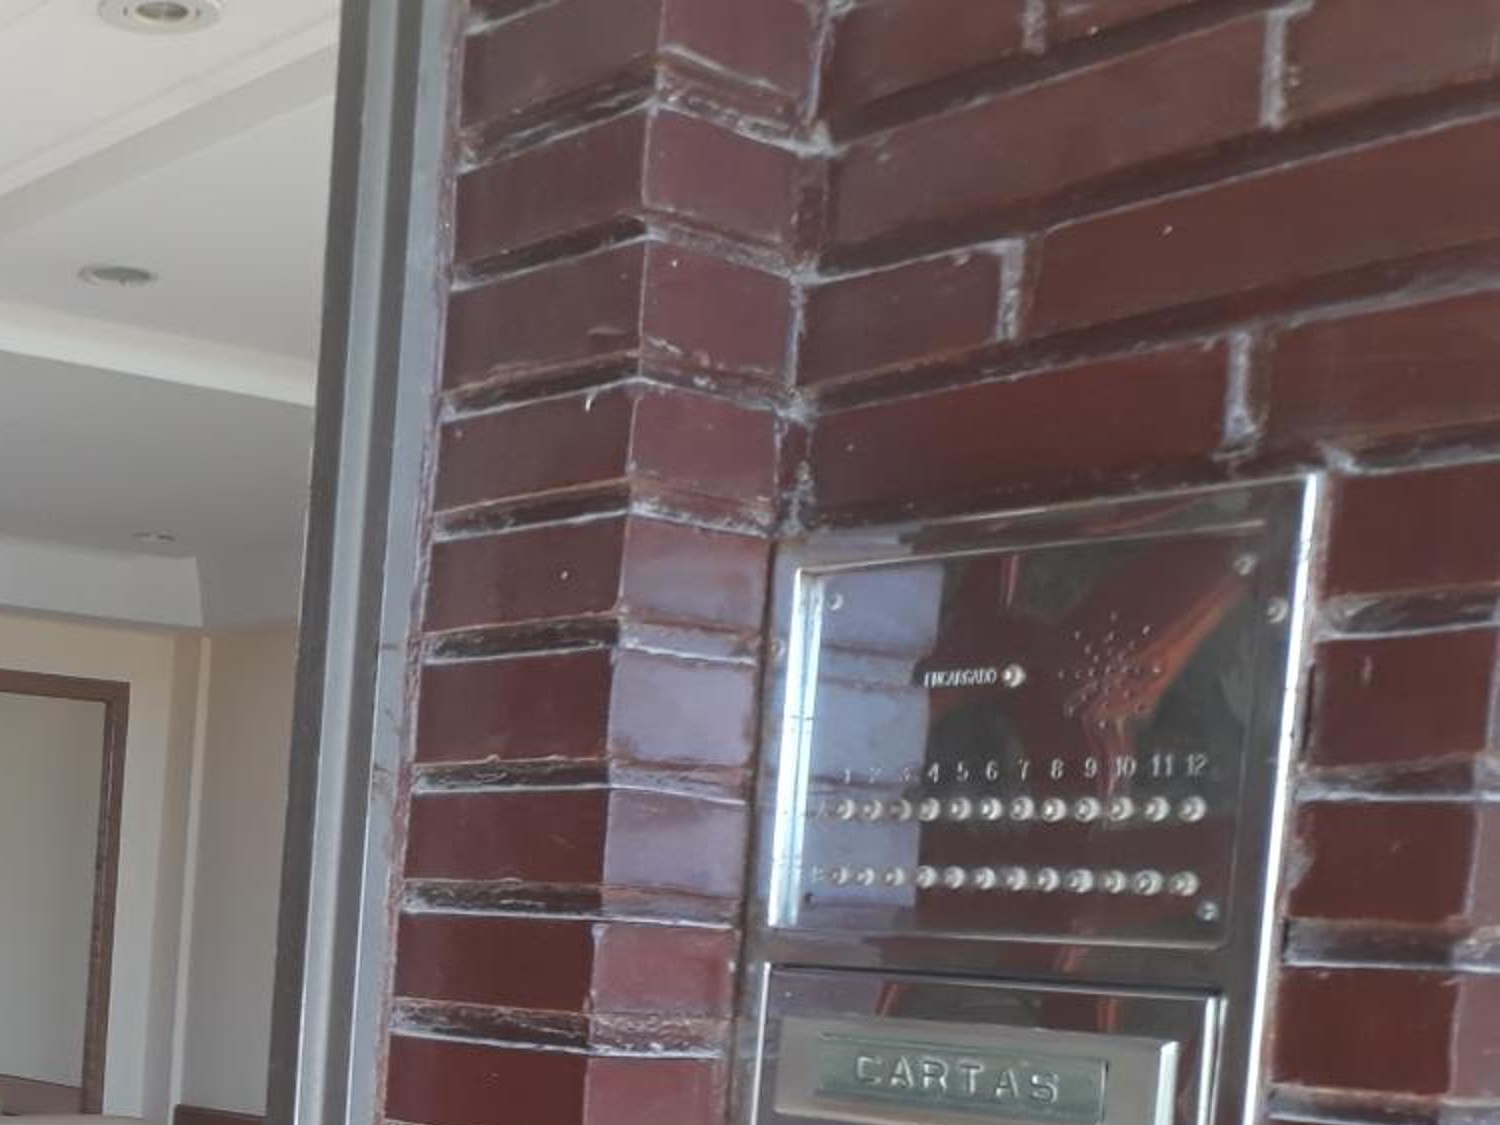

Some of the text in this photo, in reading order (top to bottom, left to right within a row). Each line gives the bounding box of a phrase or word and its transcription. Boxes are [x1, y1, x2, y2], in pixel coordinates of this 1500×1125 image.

[927, 761, 941, 783] 4
[957, 761, 970, 782] 5
[985, 759, 999, 781] 6
[1017, 757, 1030, 781] 7
[1050, 758, 1065, 780] 8
[1084, 757, 1098, 778] 9
[1115, 755, 1138, 777] 10
[1152, 753, 1173, 777] 11
[1187, 753, 1208, 777] 12
[856, 1055, 1061, 1103] CARTAS
